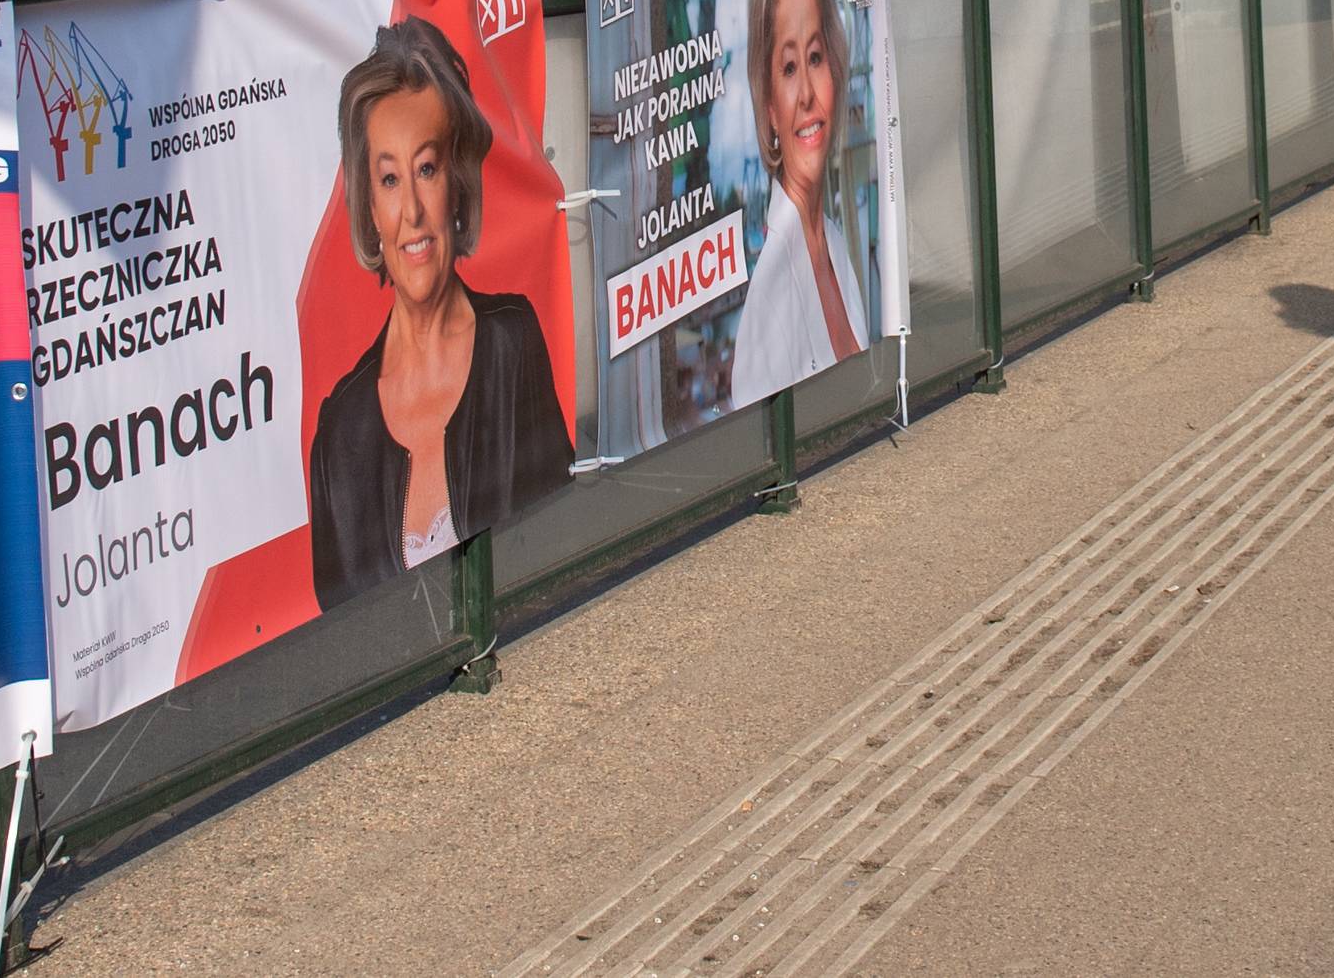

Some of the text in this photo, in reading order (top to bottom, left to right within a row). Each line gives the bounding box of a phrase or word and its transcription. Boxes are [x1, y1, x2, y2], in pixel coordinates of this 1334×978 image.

[148, 78, 287, 128] WSPÓLNA GDAŃSKA
[615, 29, 723, 102] NIEZAWODNA
[151, 120, 236, 161] DROGA 2050
[613, 67, 725, 144] JAK PORANNA
[645, 121, 698, 171] KAWA
[22, 189, 195, 270] SKUTECZNA
[638, 182, 715, 250] JOLANTA
[26, 237, 223, 330] RZECZNICZKA
[617, 225, 737, 340] BANACH
[32, 289, 226, 388] GDAŃSZCZAN
[44, 351, 274, 511] Banach
[56, 508, 194, 608] Jolanta
[152, 620, 170, 636] 2050
